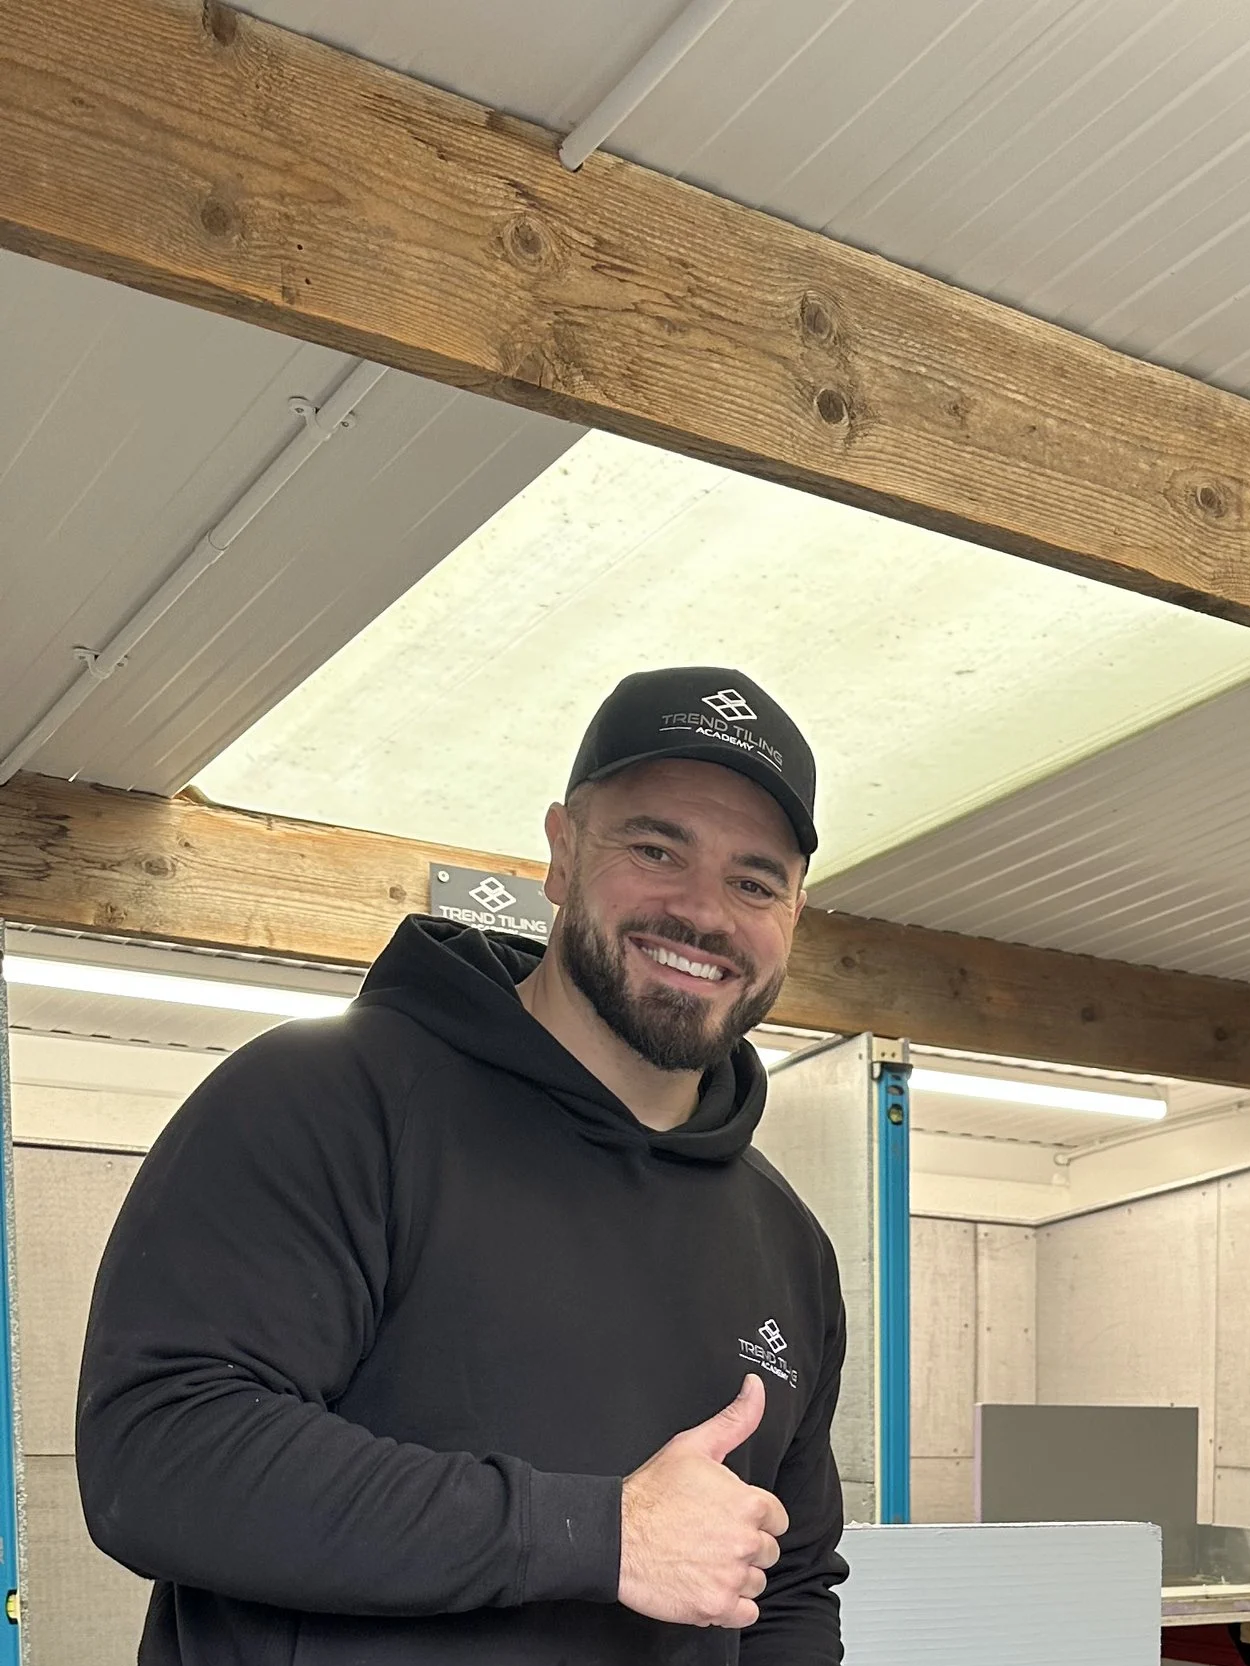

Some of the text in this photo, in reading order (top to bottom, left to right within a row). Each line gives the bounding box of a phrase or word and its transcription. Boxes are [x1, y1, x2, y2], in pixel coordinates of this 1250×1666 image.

[661, 712, 784, 765] TREND TILING
[695, 726, 755, 752] ACADEMY
[438, 905, 549, 934] TREND TILING
[737, 1337, 778, 1365] TREND
